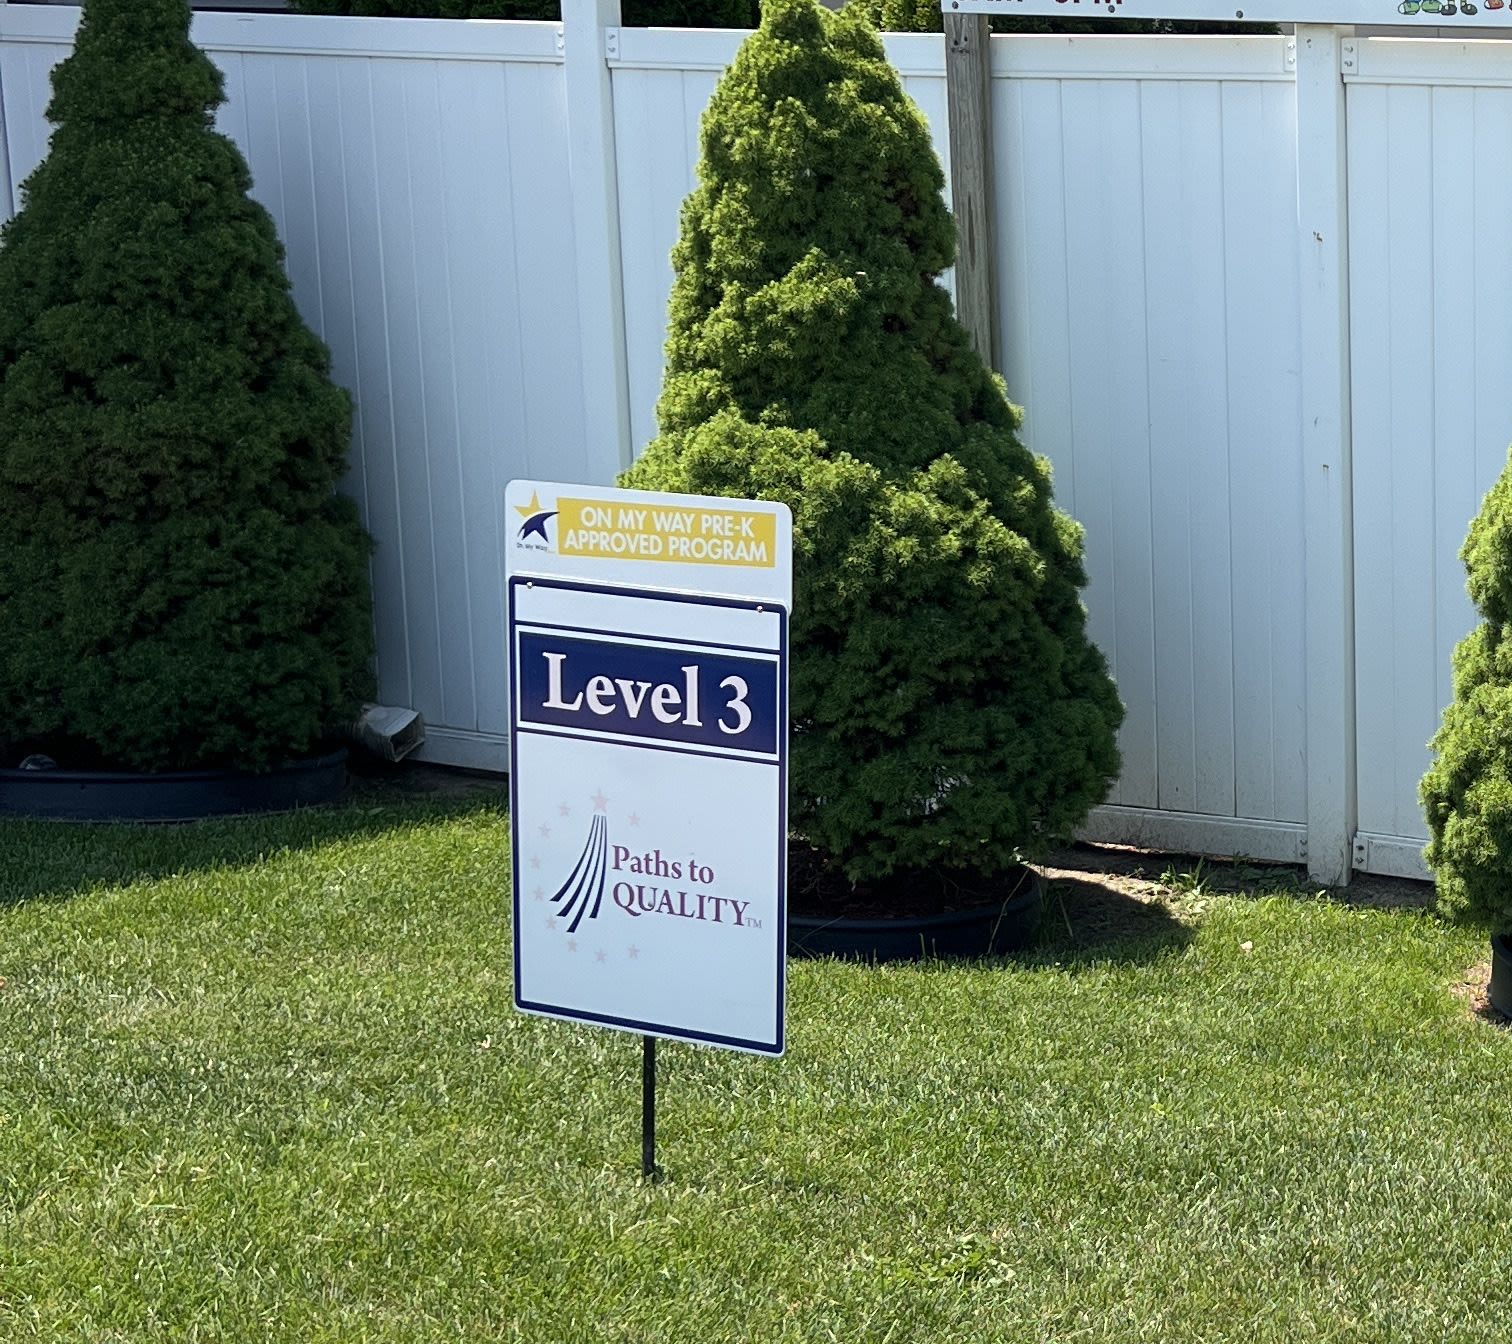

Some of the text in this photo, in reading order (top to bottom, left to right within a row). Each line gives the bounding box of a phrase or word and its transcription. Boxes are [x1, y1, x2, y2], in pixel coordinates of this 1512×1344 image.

[580, 506, 754, 538] ON MY WAY PRE-K
[564, 529, 767, 562] APPROVED PROGRAM
[542, 652, 752, 734] Level 3
[611, 844, 715, 885] Paths to
[612, 882, 750, 927] QUALITY
